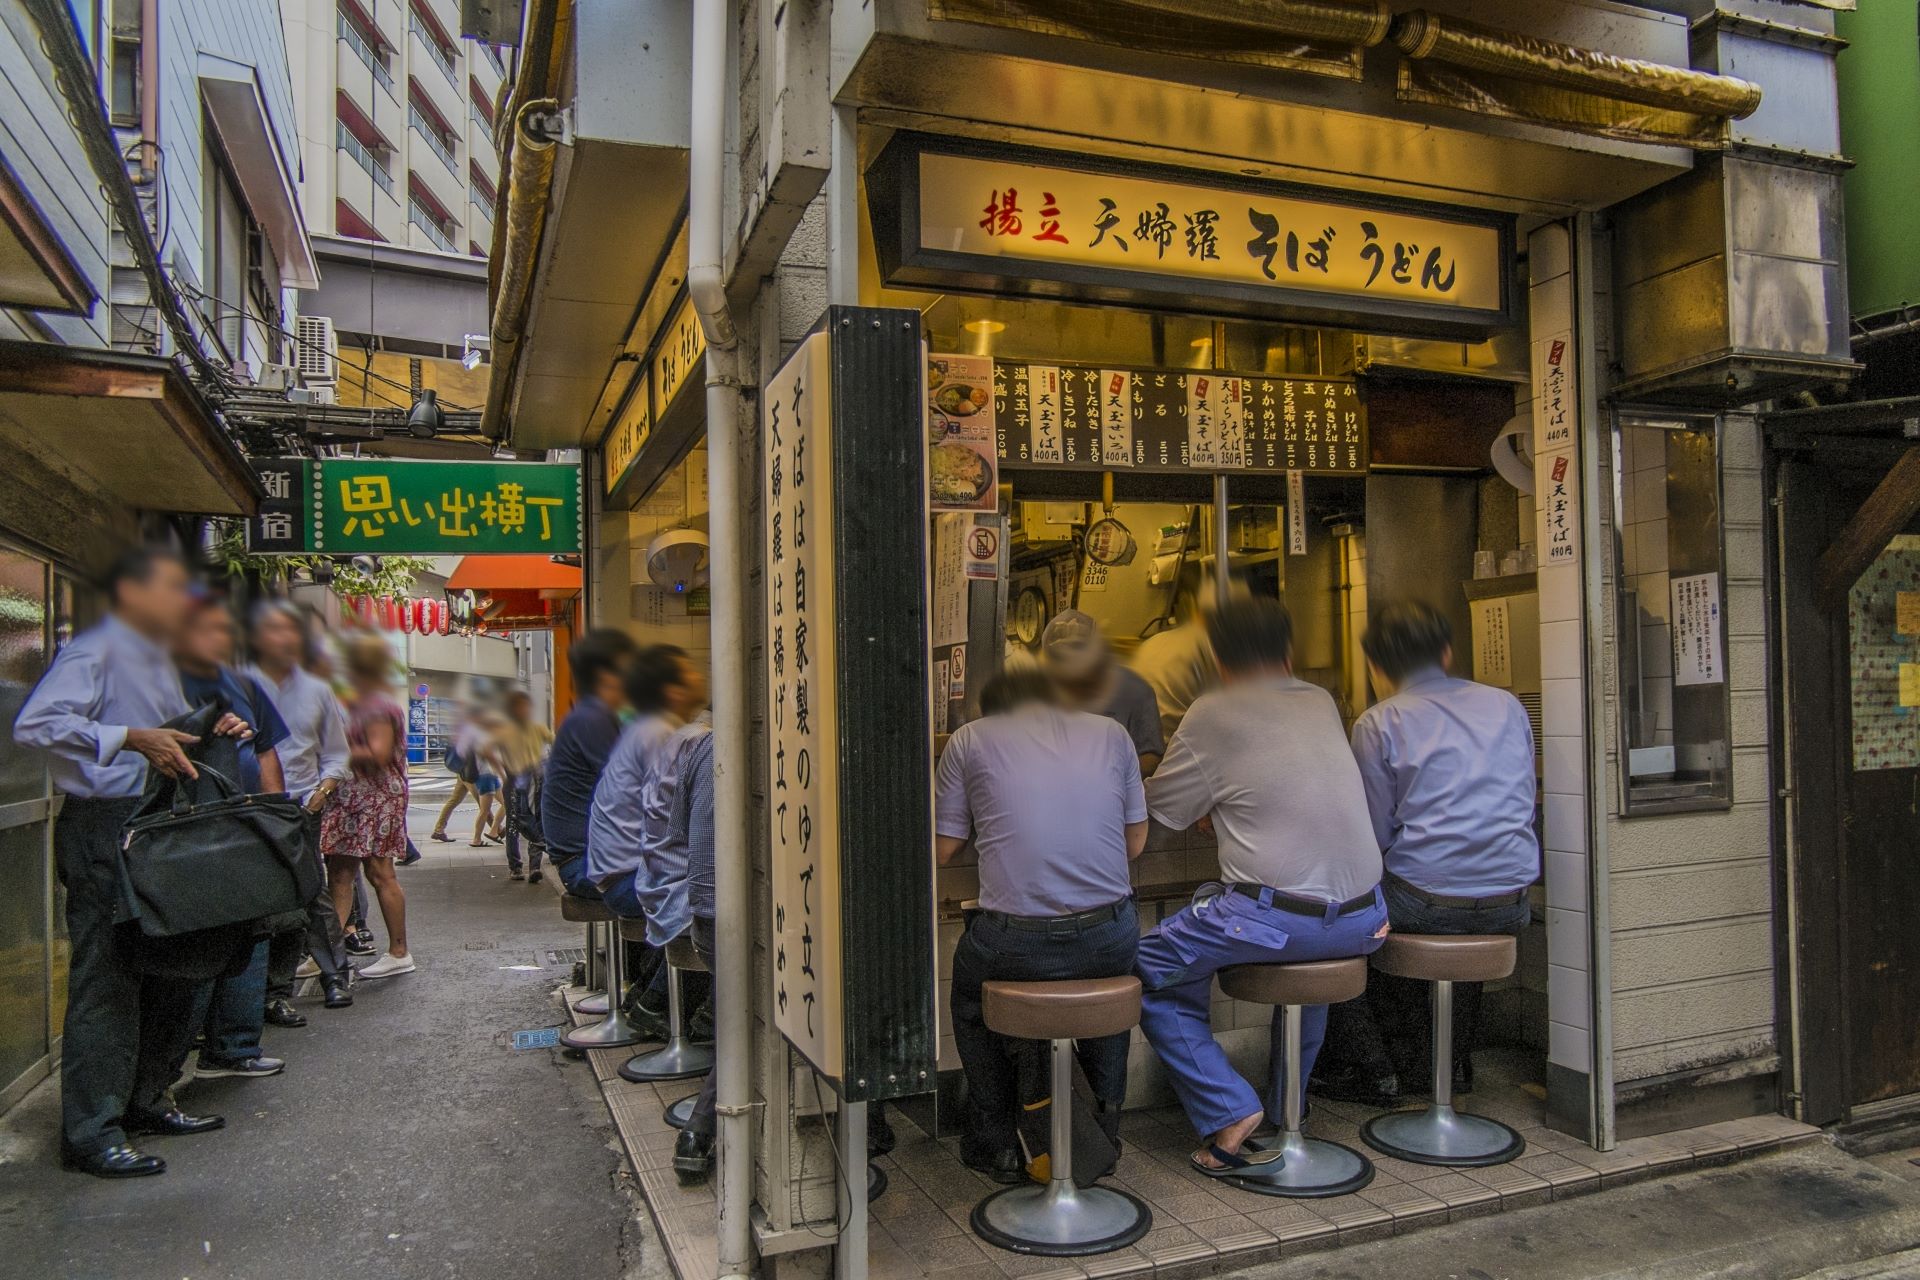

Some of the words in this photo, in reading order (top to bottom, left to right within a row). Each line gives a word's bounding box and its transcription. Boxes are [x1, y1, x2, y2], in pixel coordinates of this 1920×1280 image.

[979, 187, 1069, 245] 揚立
[1089, 198, 1221, 261] 天婦羅
[1247, 207, 1336, 280] そば
[1360, 221, 1455, 292] うどん
[994, 366, 1008, 414] 大盛り
[1014, 367, 1030, 427] 温泉玉子
[1060, 369, 1077, 429] 冷しきつね
[1084, 370, 1100, 430] 冷したぬき
[1131, 375, 1145, 420] 大もり
[1155, 375, 1167, 416] ざる
[1177, 376, 1188, 417] もり
[1219, 378, 1233, 419] 天ぷら
[1243, 379, 1254, 420] きつね
[1262, 380, 1275, 421] わかめ
[1303, 383, 1317, 422] 玉子
[1324, 383, 1336, 423] たぬき
[1344, 384, 1356, 423] かけ
[1549, 367, 1566, 425] 天ぷらそば
[1037, 394, 1056, 449] 天玉そば
[1107, 395, 1125, 450] 天玉せいろ
[1195, 399, 1212, 452] 天玉そば
[1219, 421, 1230, 451] うどん
[1231, 422, 1241, 451] そば
[1547, 428, 1569, 442] 440円
[1034, 450, 1059, 461] 400円
[1105, 452, 1129, 463] 400円
[1192, 452, 1215, 464] 400円
[1221, 451, 1242, 465] 350円
[260, 470, 293, 540] 新宿
[339, 475, 563, 541] 思い出横丁
[1552, 484, 1569, 542] 天玉そば
[1086, 567, 1108, 575] 3346
[1551, 545, 1572, 557] 490円
[1085, 576, 1106, 585] 0110
[771, 399, 787, 845] 天婦羅は揚げ立て
[791, 376, 815, 1038] そばは自家製のゆで立て
